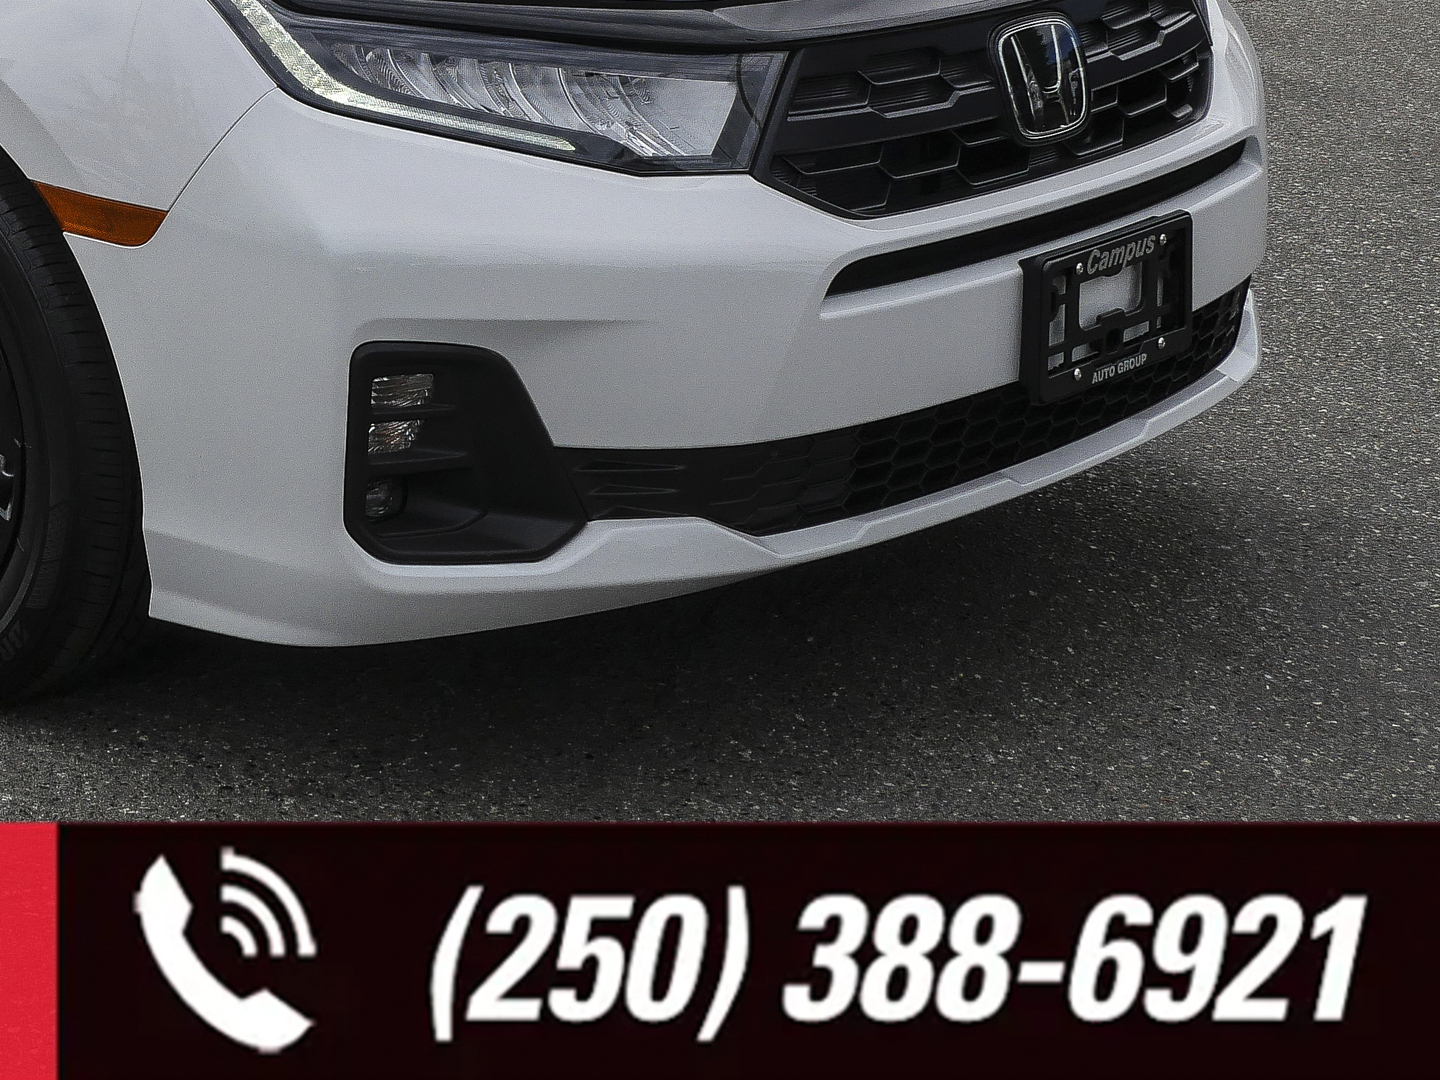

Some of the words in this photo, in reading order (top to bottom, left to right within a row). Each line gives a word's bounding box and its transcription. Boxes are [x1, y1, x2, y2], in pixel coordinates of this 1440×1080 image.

[1086, 234, 1156, 275] Campus
[1091, 365, 1116, 385] AUTO
[1116, 353, 1148, 374] GROUP
